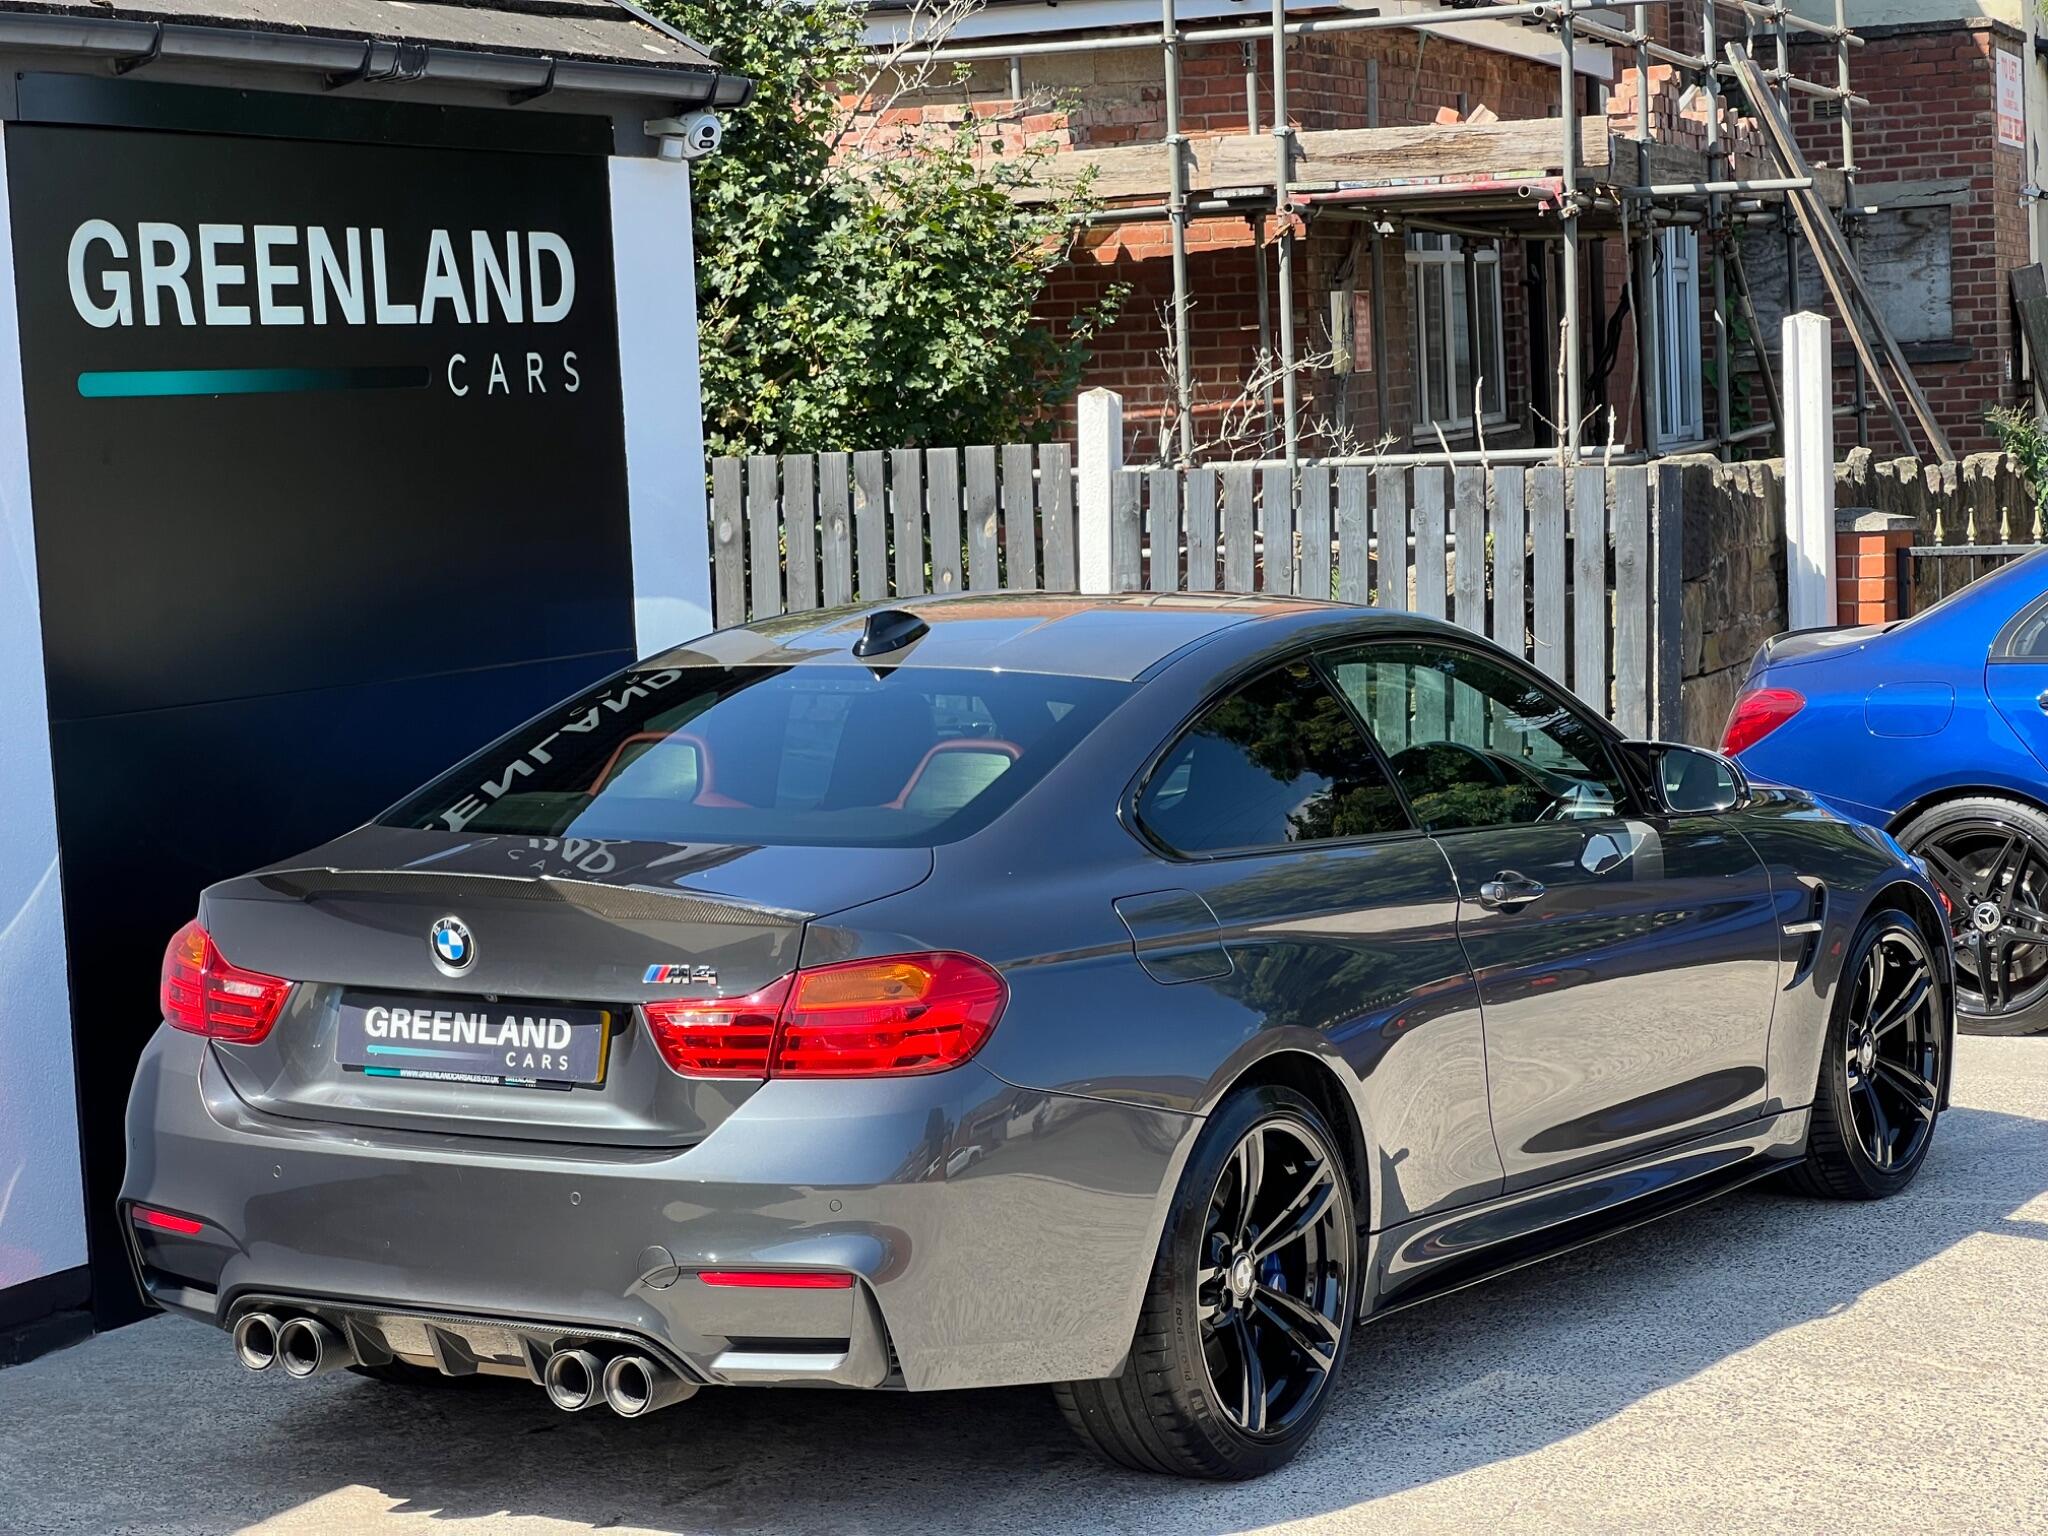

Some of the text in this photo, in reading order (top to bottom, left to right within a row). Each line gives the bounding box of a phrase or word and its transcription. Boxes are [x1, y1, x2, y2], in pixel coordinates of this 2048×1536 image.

[67, 218, 576, 328] GREENLAND
[447, 351, 580, 397] CARS
[365, 1006, 571, 1050] GREENLAND
[505, 1051, 569, 1071] CARS
